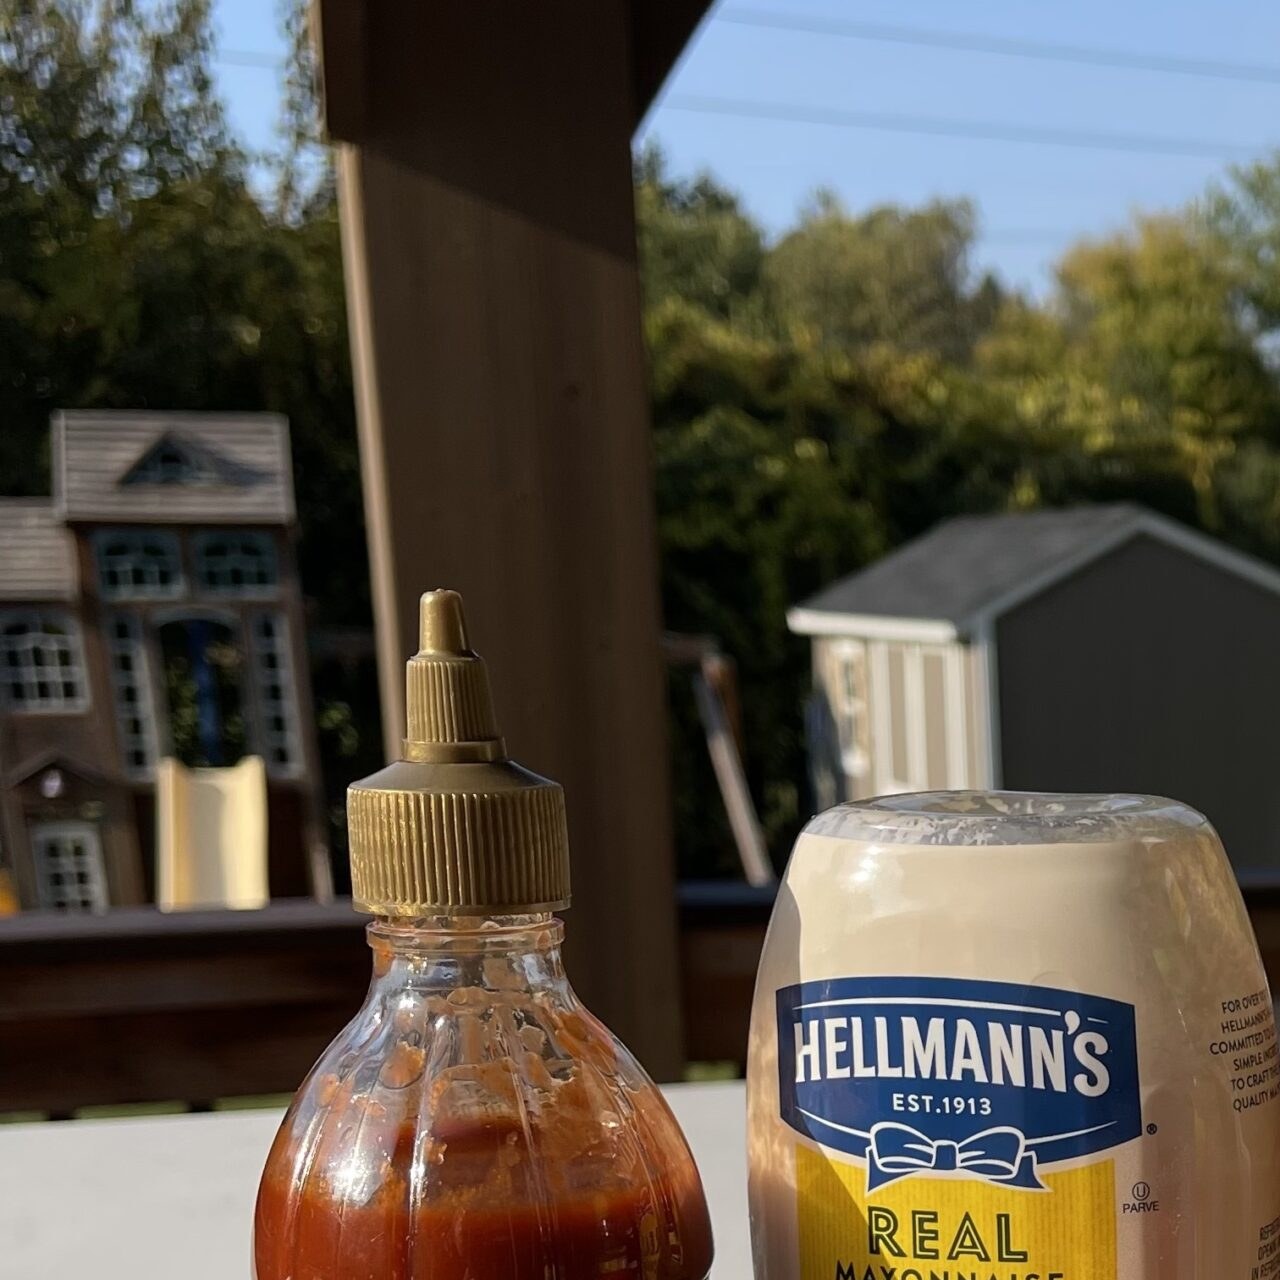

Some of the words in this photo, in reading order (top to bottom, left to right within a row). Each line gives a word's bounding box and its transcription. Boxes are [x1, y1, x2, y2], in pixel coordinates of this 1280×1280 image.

[1222, 999, 1241, 1014] FOR
[794, 1011, 1111, 1098] HELLMANN'S
[1233, 1052, 1263, 1071] SIMPLE
[1231, 1078, 1245, 1091] TO
[1122, 1200, 1160, 1214] PARVE
[867, 1205, 1028, 1263] REAL
